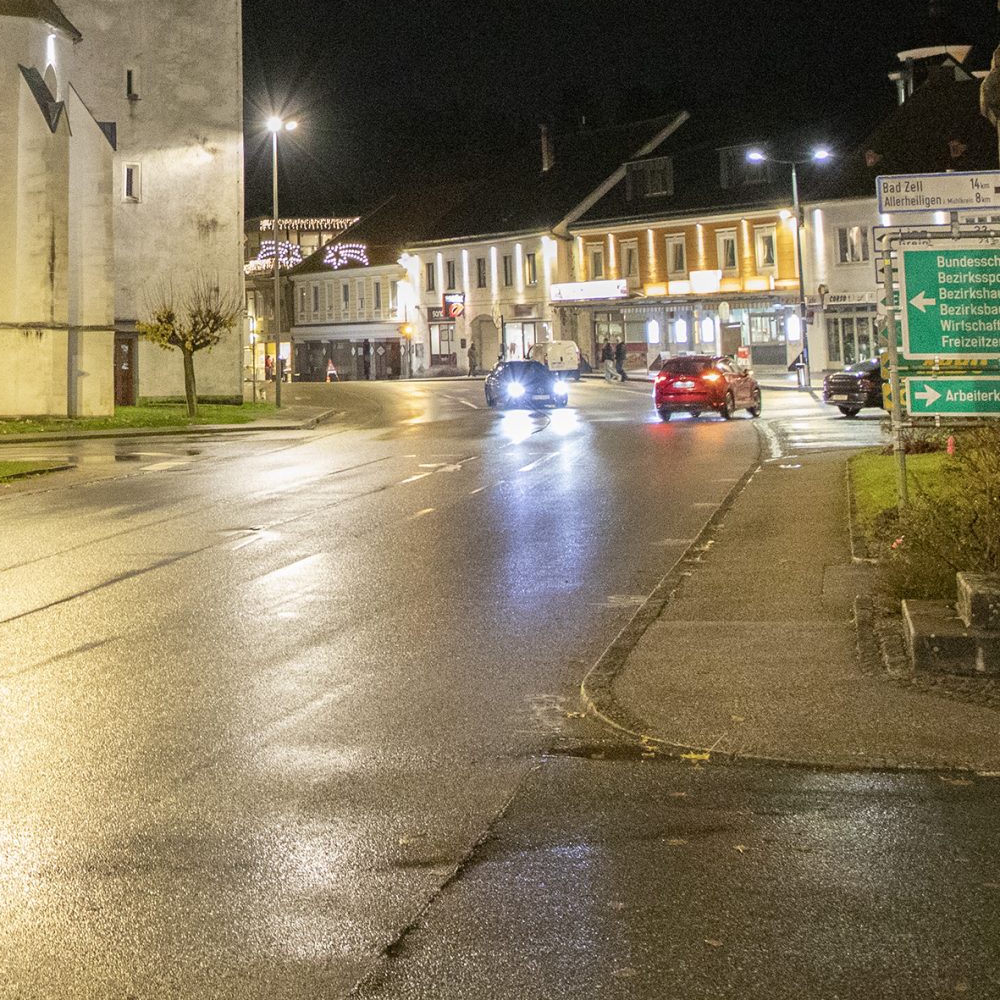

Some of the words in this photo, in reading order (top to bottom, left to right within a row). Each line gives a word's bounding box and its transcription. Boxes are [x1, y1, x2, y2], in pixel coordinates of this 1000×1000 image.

[883, 182, 901, 193] Bad
[904, 181, 923, 192] Zell
[970, 178, 980, 190] 14
[884, 195, 942, 208] Allerheiligen
[975, 192, 981, 203] 8
[940, 303, 1000, 316] Bezirksba
[942, 335, 1000, 348] Freizeitze
[945, 389, 1000, 401] Arbeiterk
